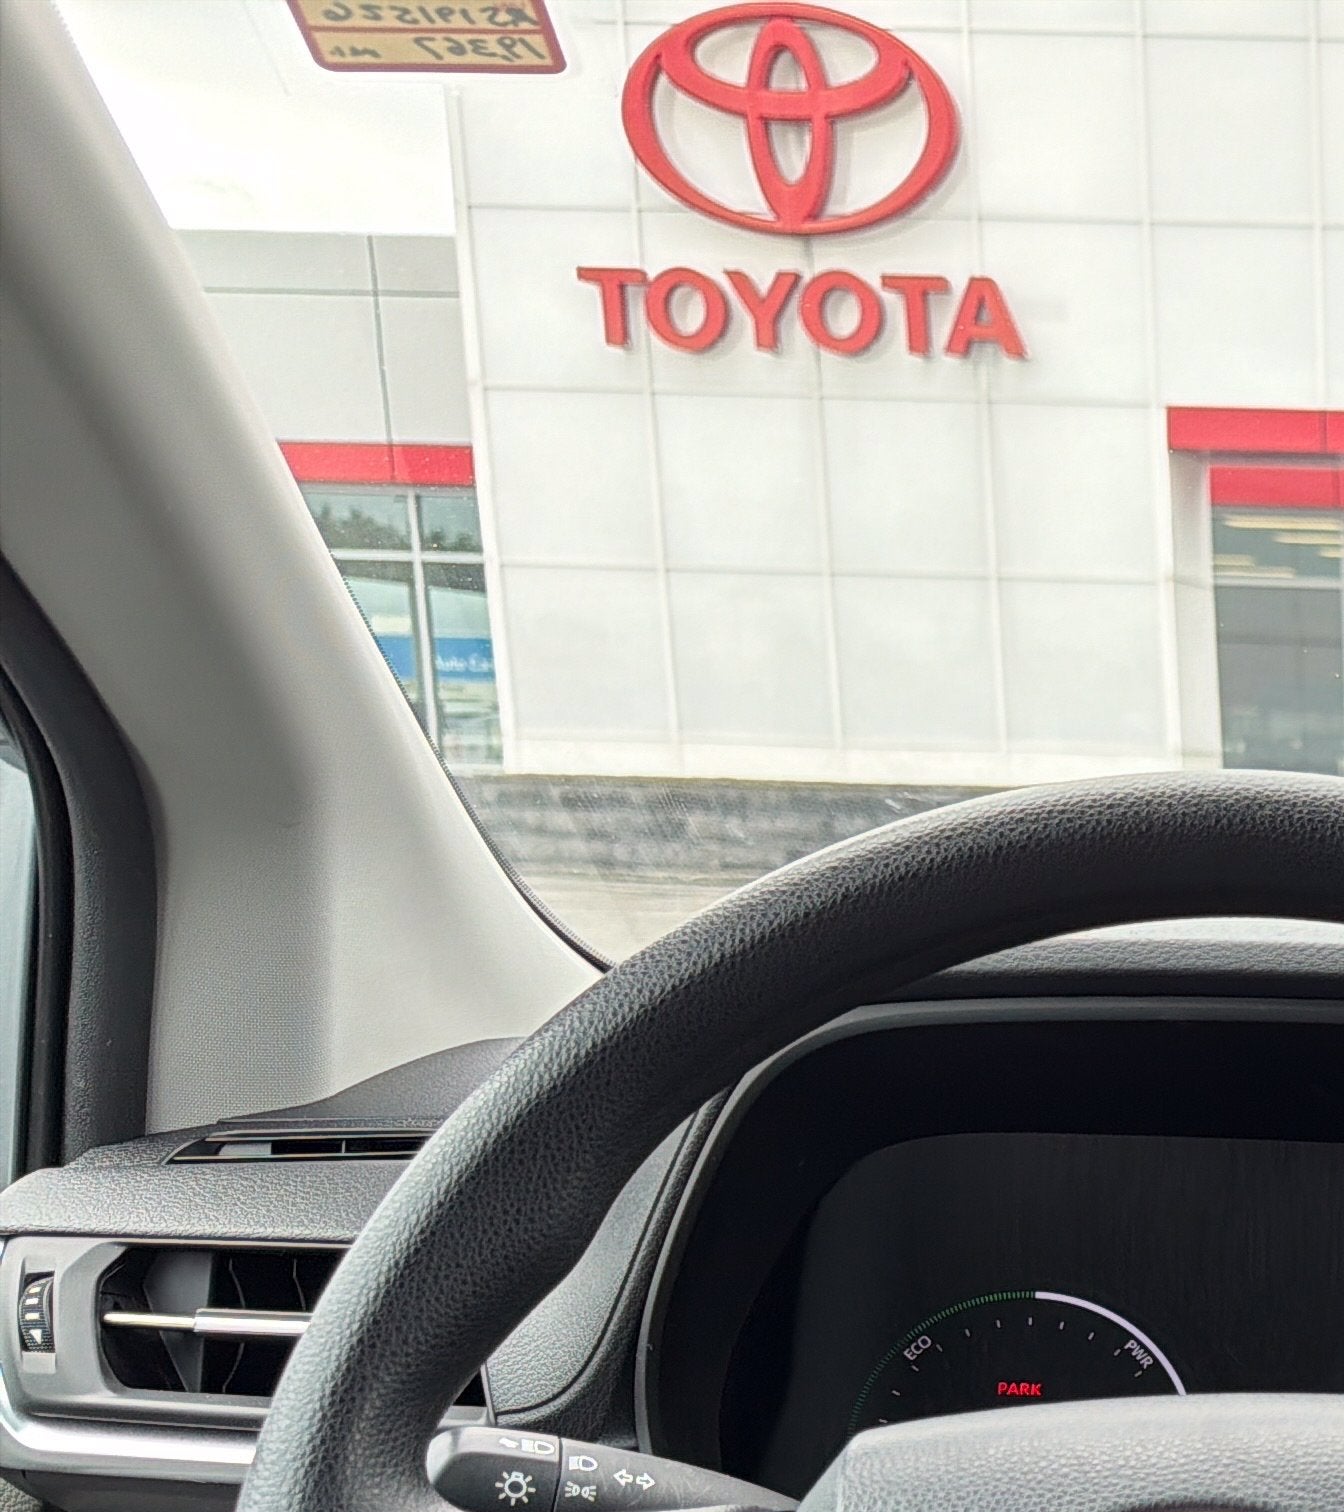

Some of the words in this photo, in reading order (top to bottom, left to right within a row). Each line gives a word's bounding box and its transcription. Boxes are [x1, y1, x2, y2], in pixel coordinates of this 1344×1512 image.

[576, 266, 1028, 360] TOYOTA
[903, 1335, 932, 1362] ECO
[1124, 1340, 1154, 1370] PWR
[998, 1383, 1042, 1396] PARK
